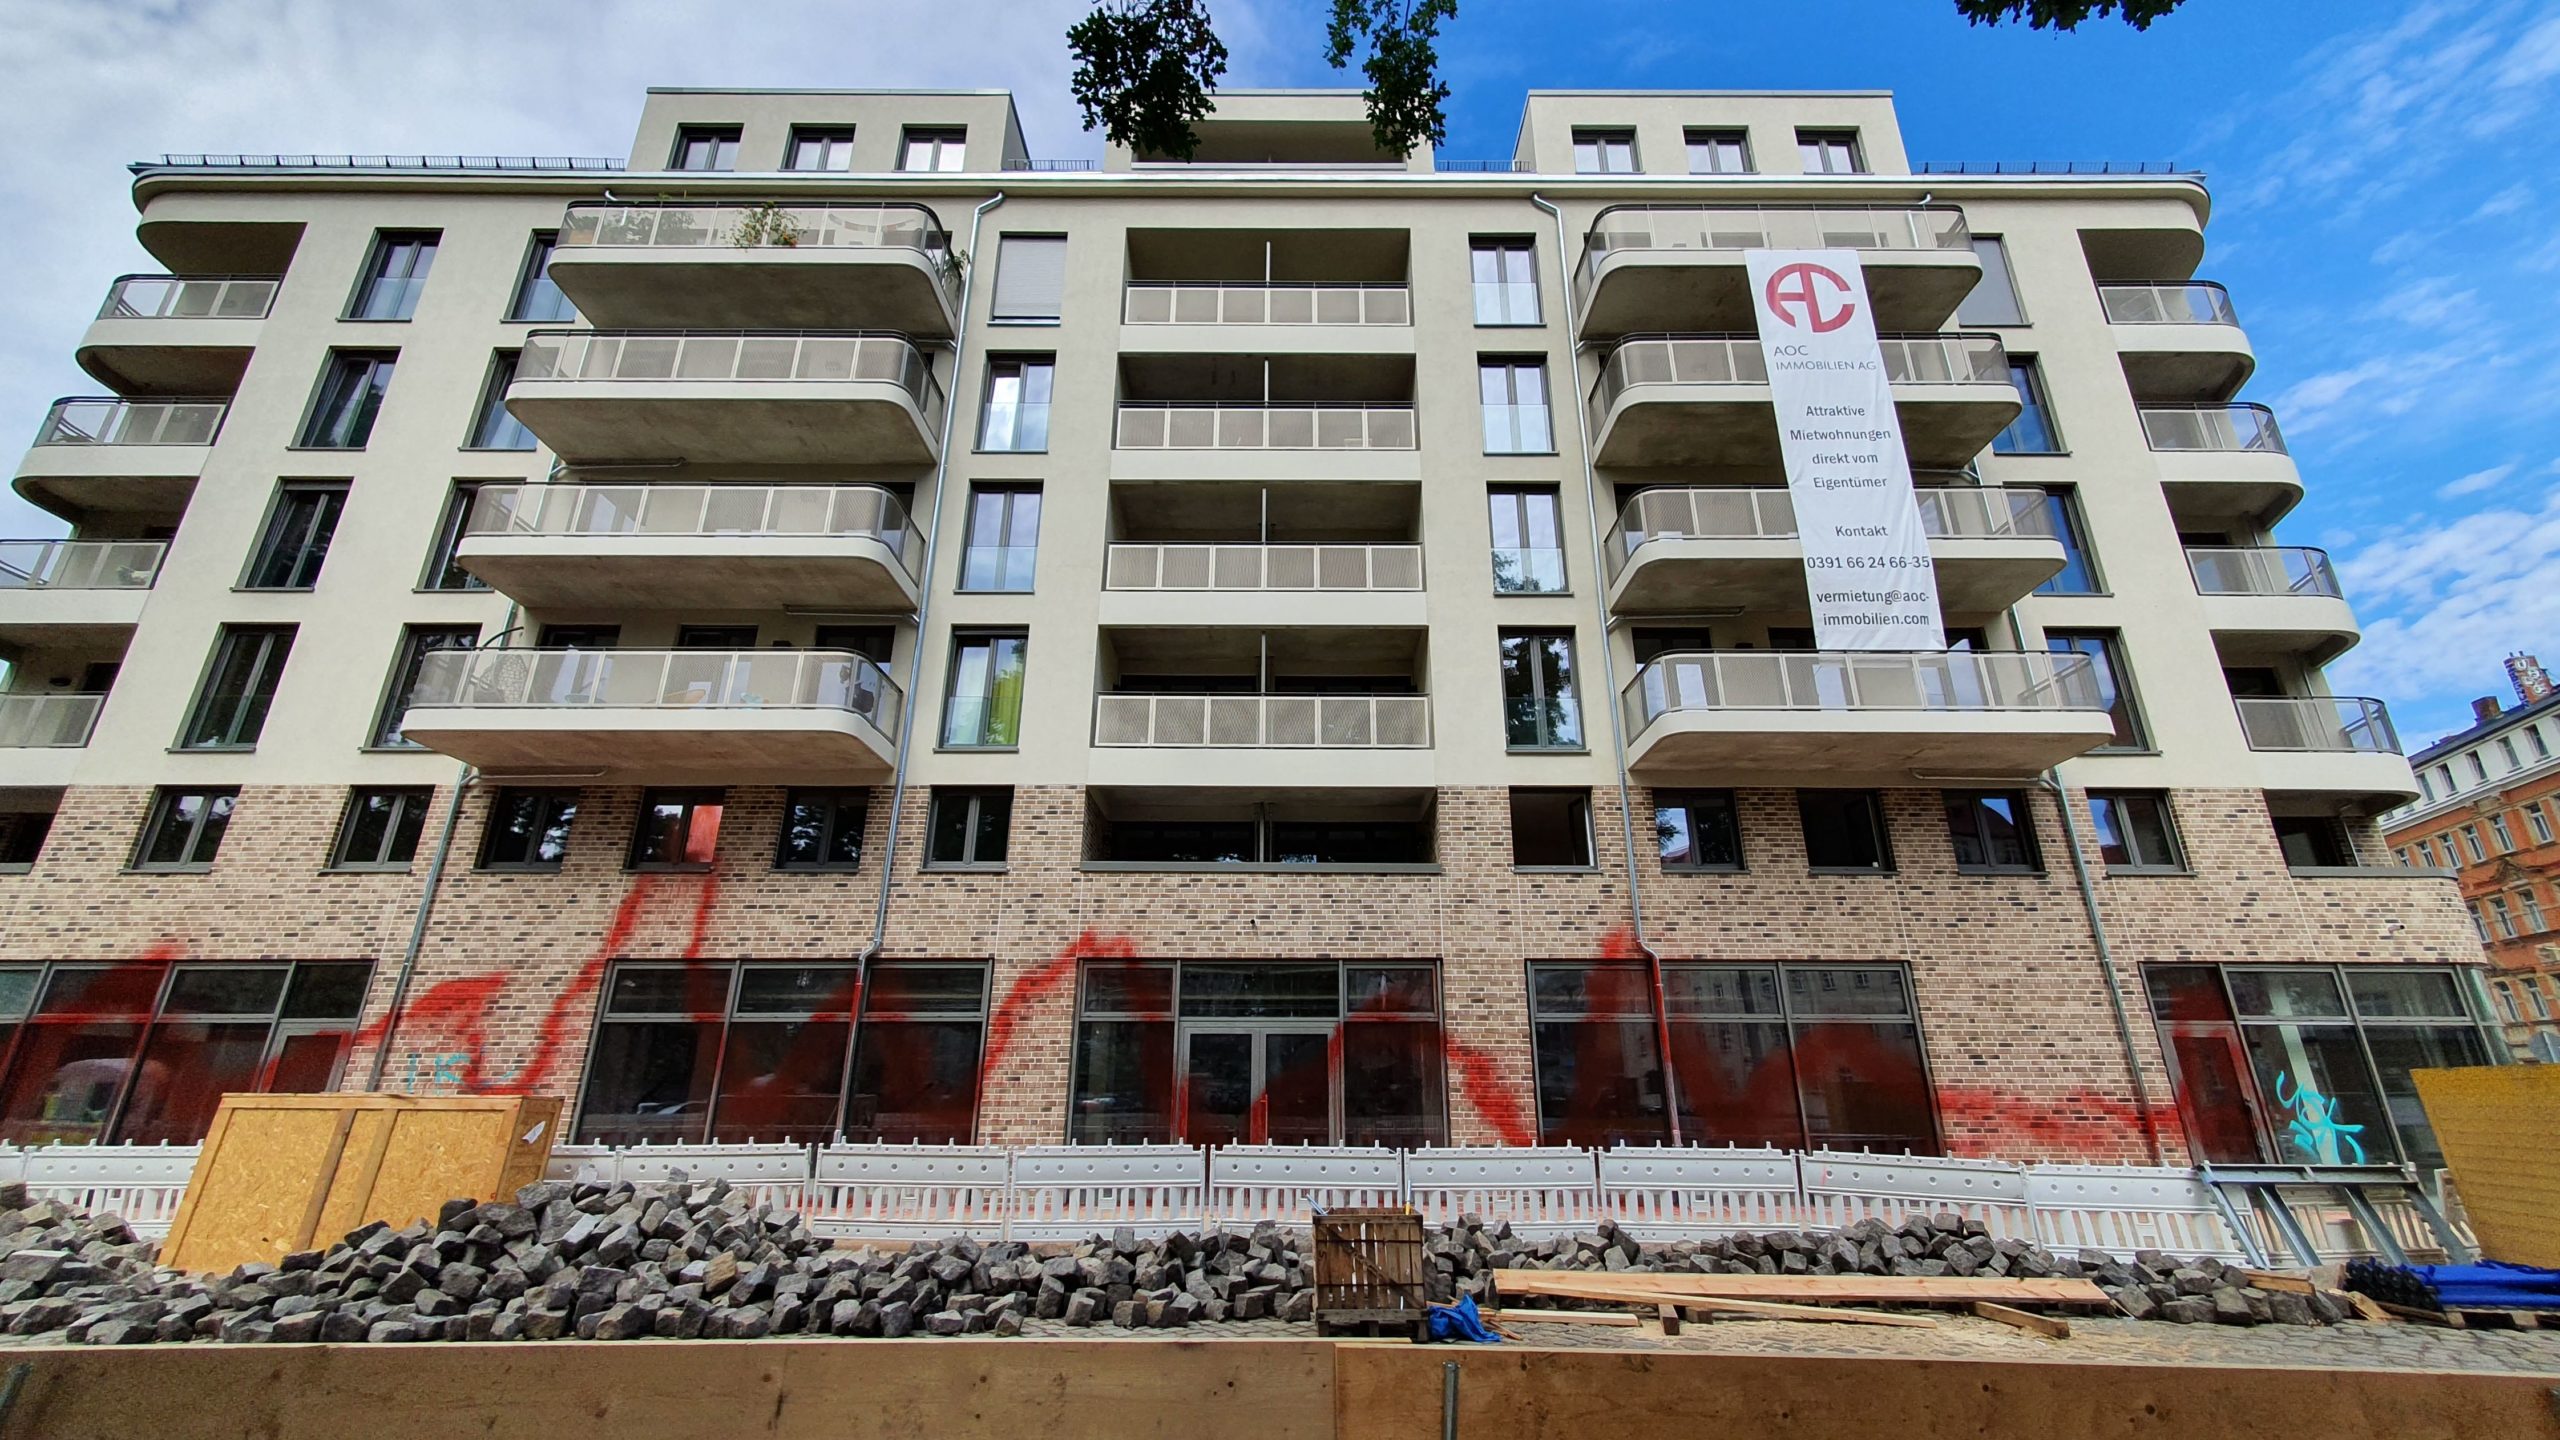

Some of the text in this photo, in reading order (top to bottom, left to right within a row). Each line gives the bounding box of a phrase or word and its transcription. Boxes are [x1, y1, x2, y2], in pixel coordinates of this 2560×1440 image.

[1773, 344, 1809, 356] AOC
[1776, 360, 1877, 371] IMMOBILIEN AG
[1806, 404, 1866, 417] Attraktive
[1790, 428, 1892, 442] Mietwohnungen
[1812, 453, 1879, 465] direkt vom
[1813, 476, 1888, 491] Eigentümer
[1835, 525, 1889, 537] Kontakt
[1807, 555, 1931, 569] 0391 66 24 66-35
[1816, 589, 1930, 605] vermietung@aoc-
[1823, 612, 1930, 626] immobilien.com
